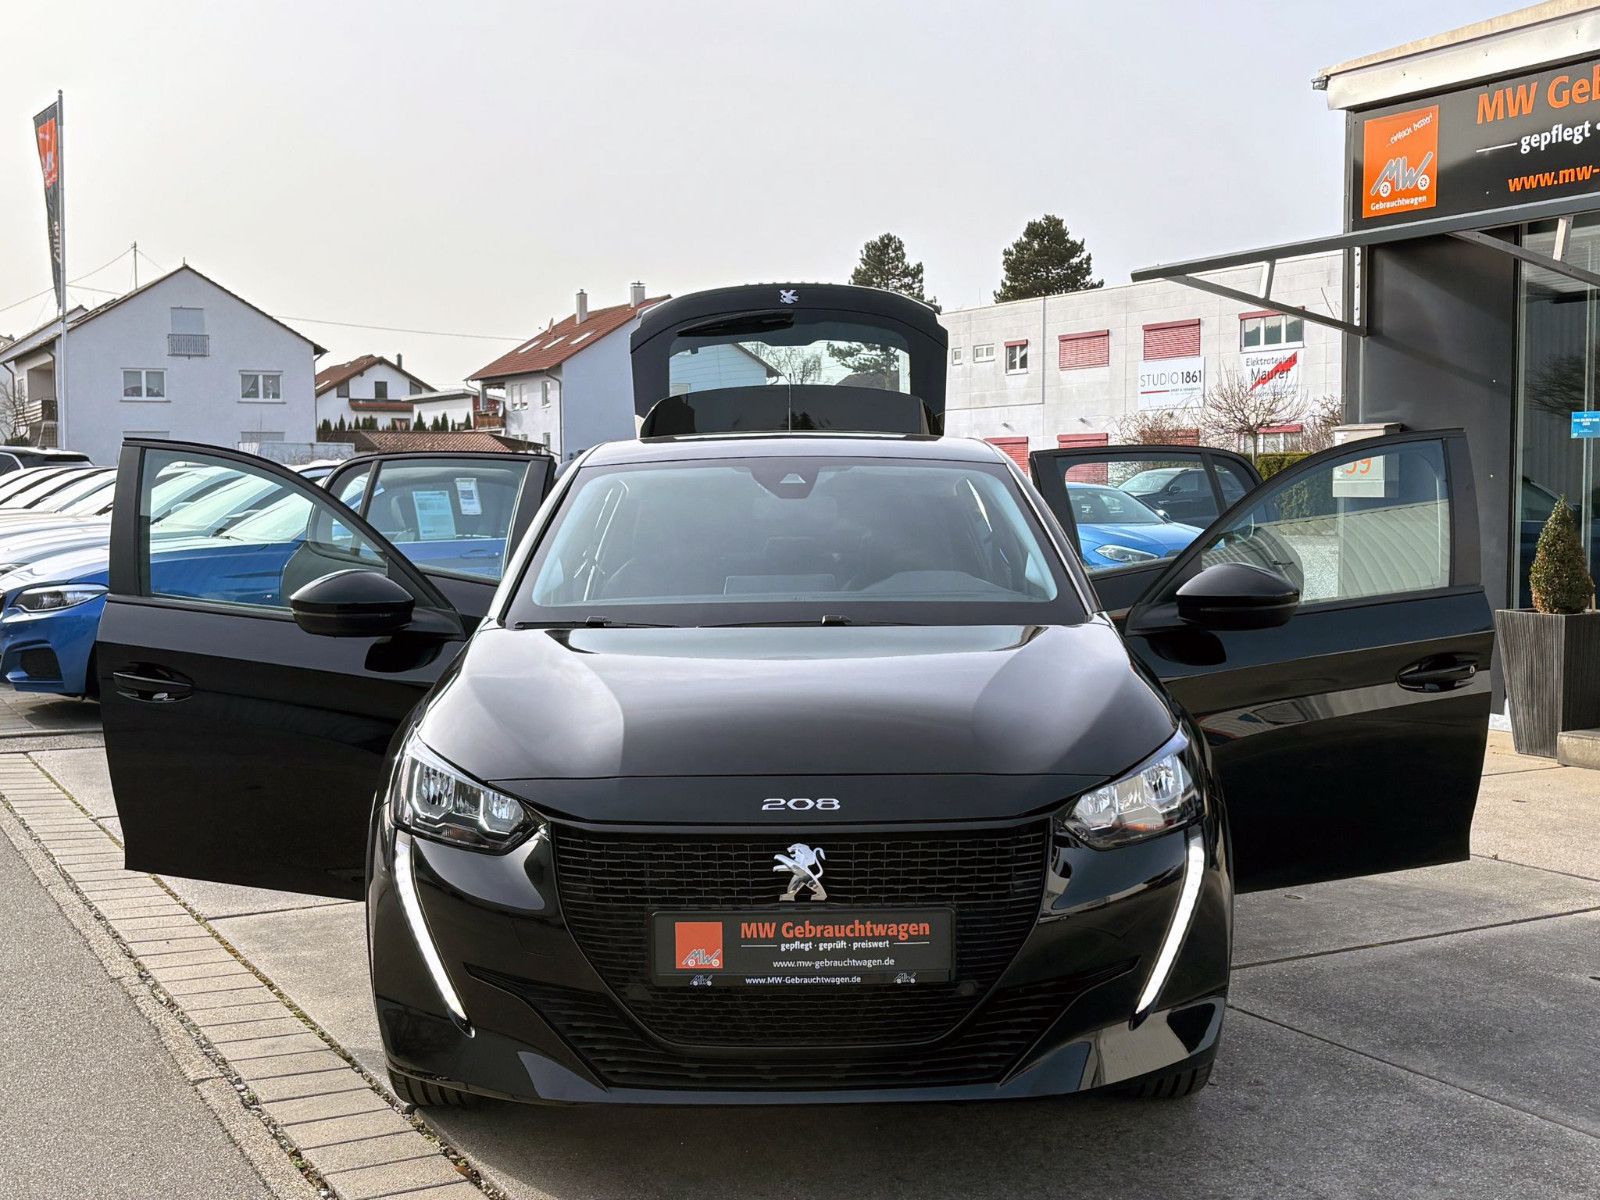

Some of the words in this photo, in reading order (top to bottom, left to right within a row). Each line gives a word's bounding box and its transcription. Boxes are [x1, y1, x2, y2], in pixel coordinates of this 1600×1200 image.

[1477, 81, 1538, 125] MW
[1520, 120, 1591, 154] gepflegt
[1370, 151, 1433, 197] MW
[1370, 195, 1427, 211] Gebrauchtwagen
[1140, 371, 1179, 388] STUDIO
[1181, 370, 1202, 384] 1861
[1250, 367, 1291, 383] Maurer
[761, 798, 841, 811] 208
[741, 922, 776, 939] MW
[781, 920, 930, 941] Gebrauchtwagen
[780, 941, 813, 952] gepflegt
[818, 940, 847, 951] geprüft
[853, 940, 890, 950] preiswert
[682, 949, 721, 966] MW
[772, 957, 895, 969] www.mw-gebrauchtwagen.de
[745, 975, 862, 985] www.MW-Gebrauchtwagen.de
